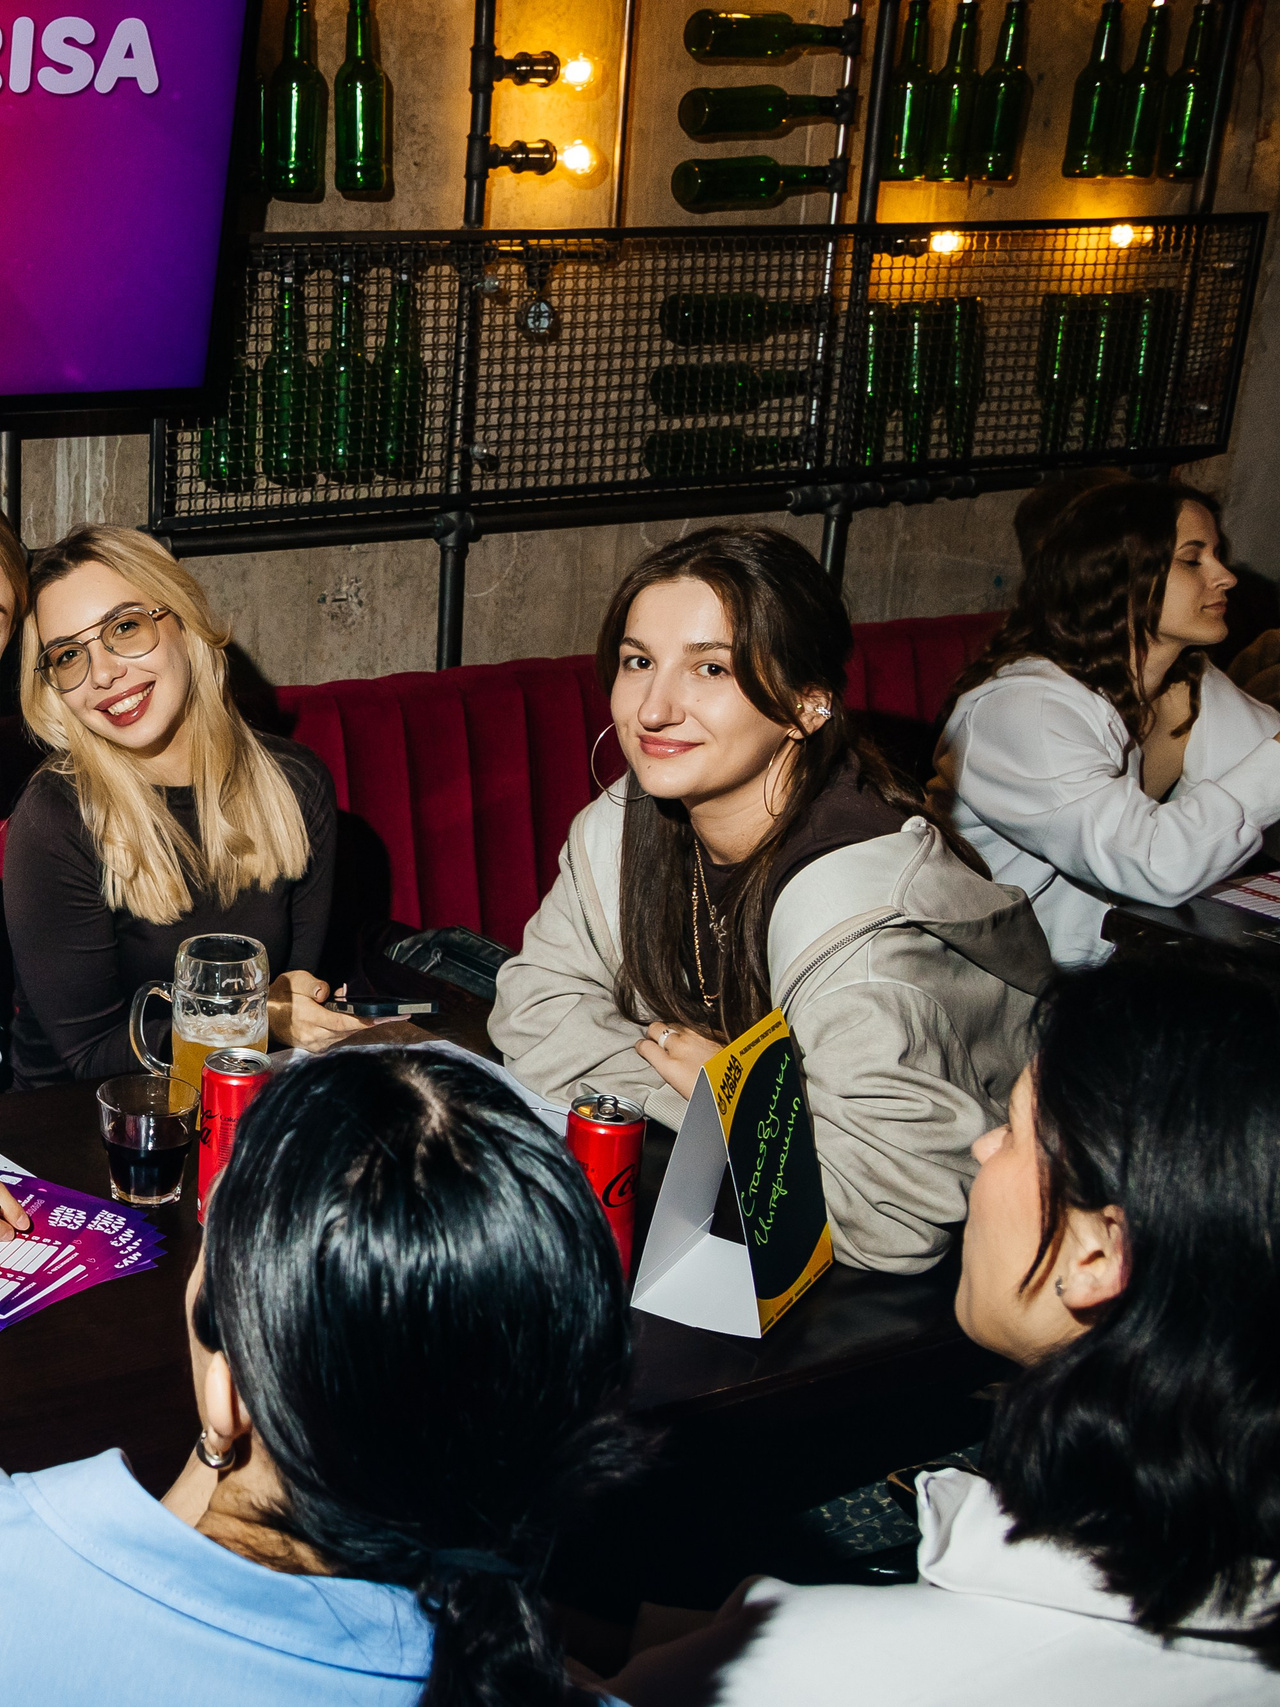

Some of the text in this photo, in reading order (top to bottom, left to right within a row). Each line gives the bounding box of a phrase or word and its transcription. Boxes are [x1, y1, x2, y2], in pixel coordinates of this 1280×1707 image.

[720, 1054, 738, 1098] МАМА
[725, 1060, 743, 1104] КВИЗ!
[57, 1207, 76, 1227] ЫКА
[67, 1209, 86, 1230] МУЗ
[104, 1216, 127, 1234] МУЗ
[110, 1228, 135, 1246] МУЗ
